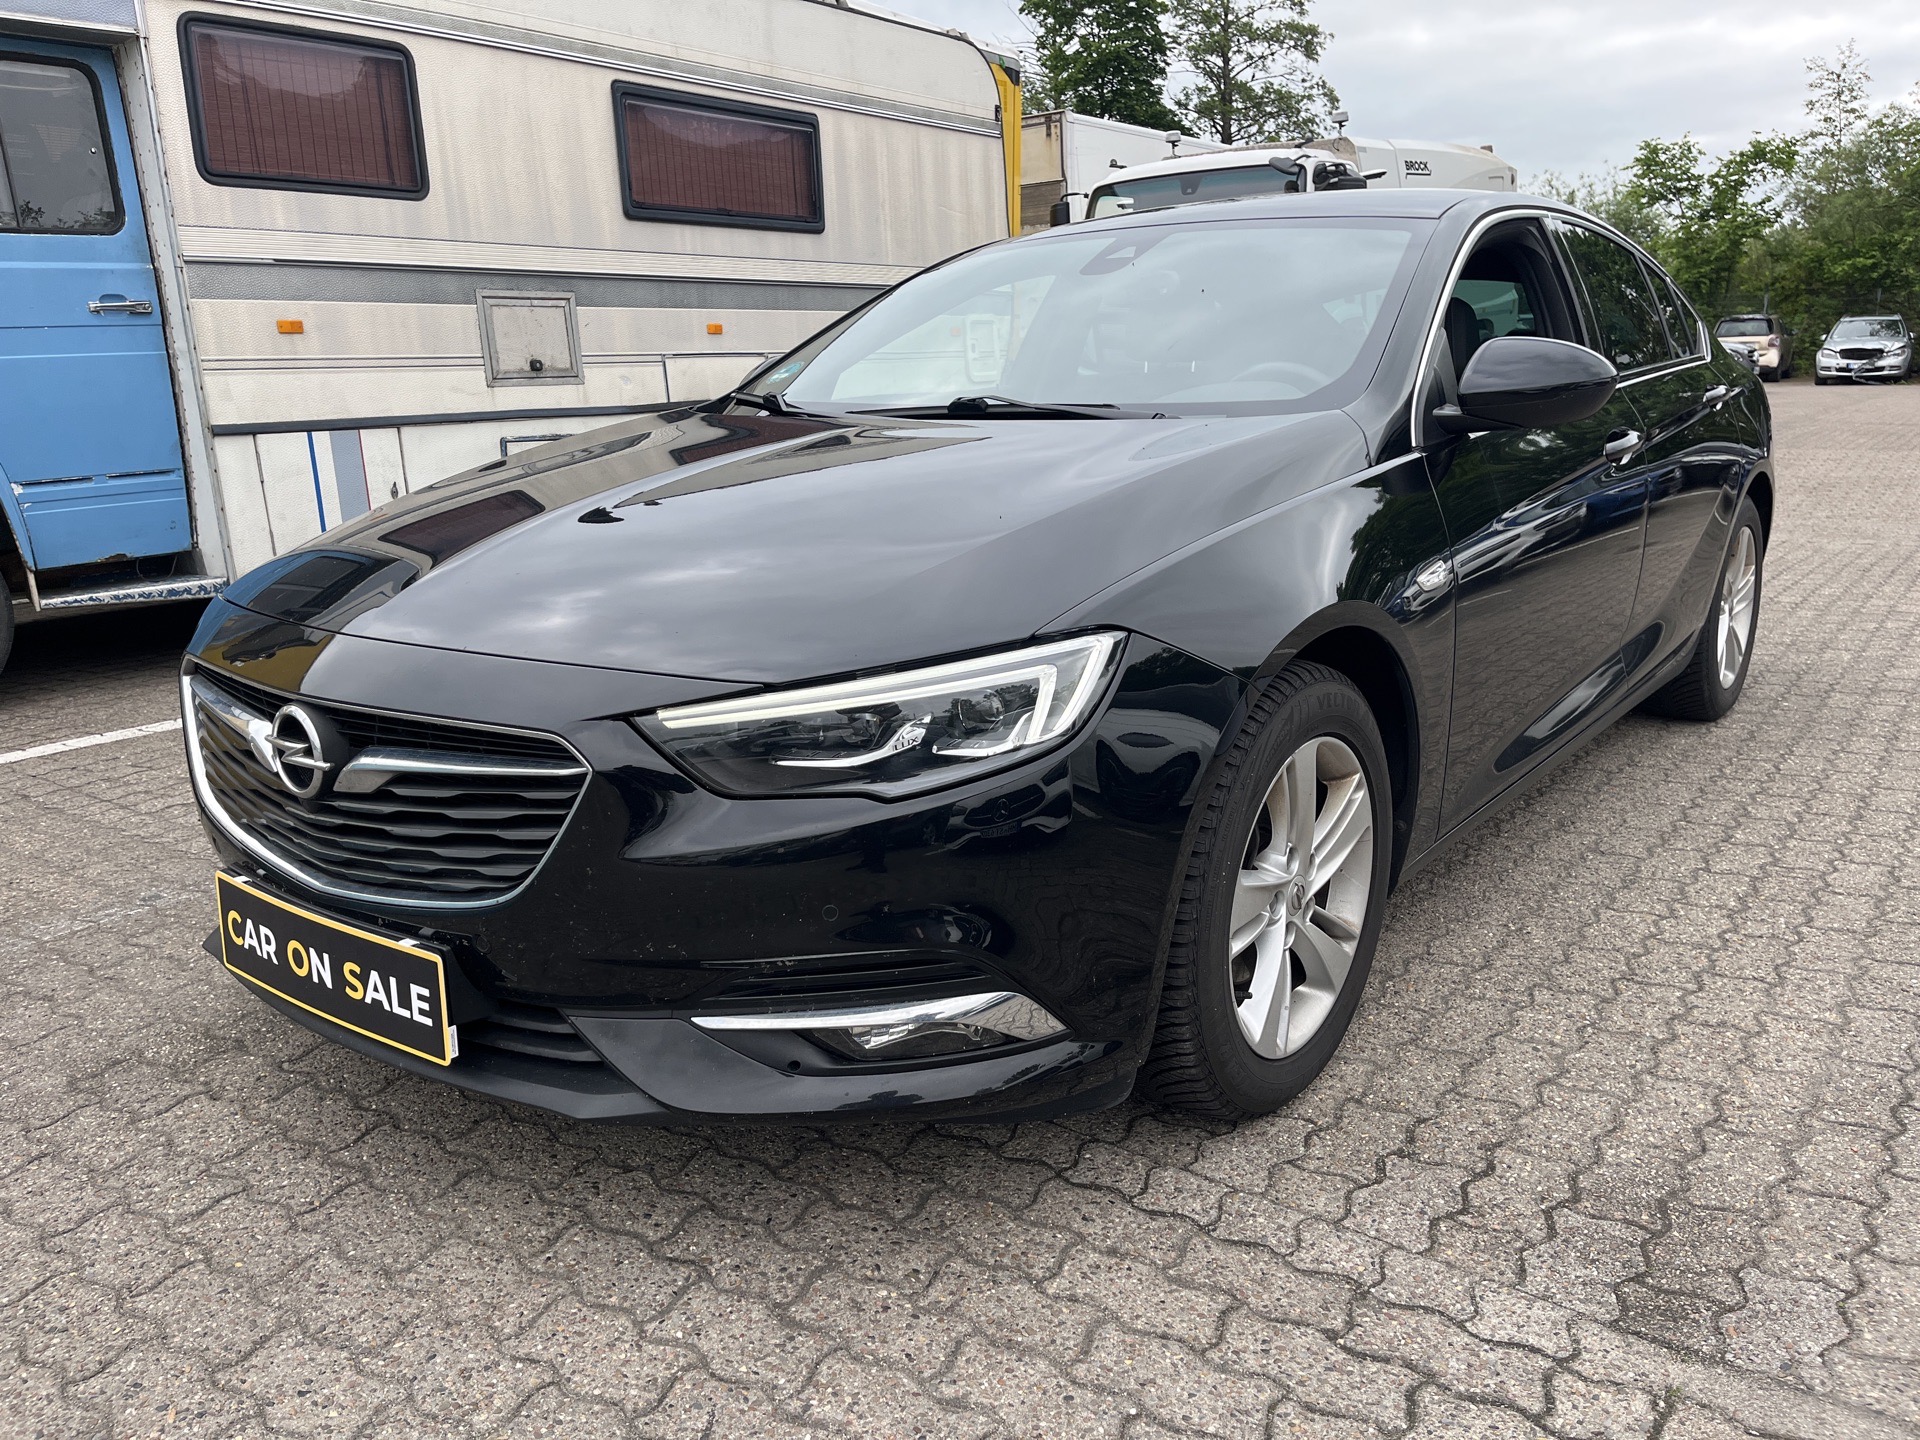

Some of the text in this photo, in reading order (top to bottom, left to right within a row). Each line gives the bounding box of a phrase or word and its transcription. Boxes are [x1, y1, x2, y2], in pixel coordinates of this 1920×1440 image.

[1404, 160, 1429, 172] BROCK
[227, 910, 433, 1027] CAR ON SALE
